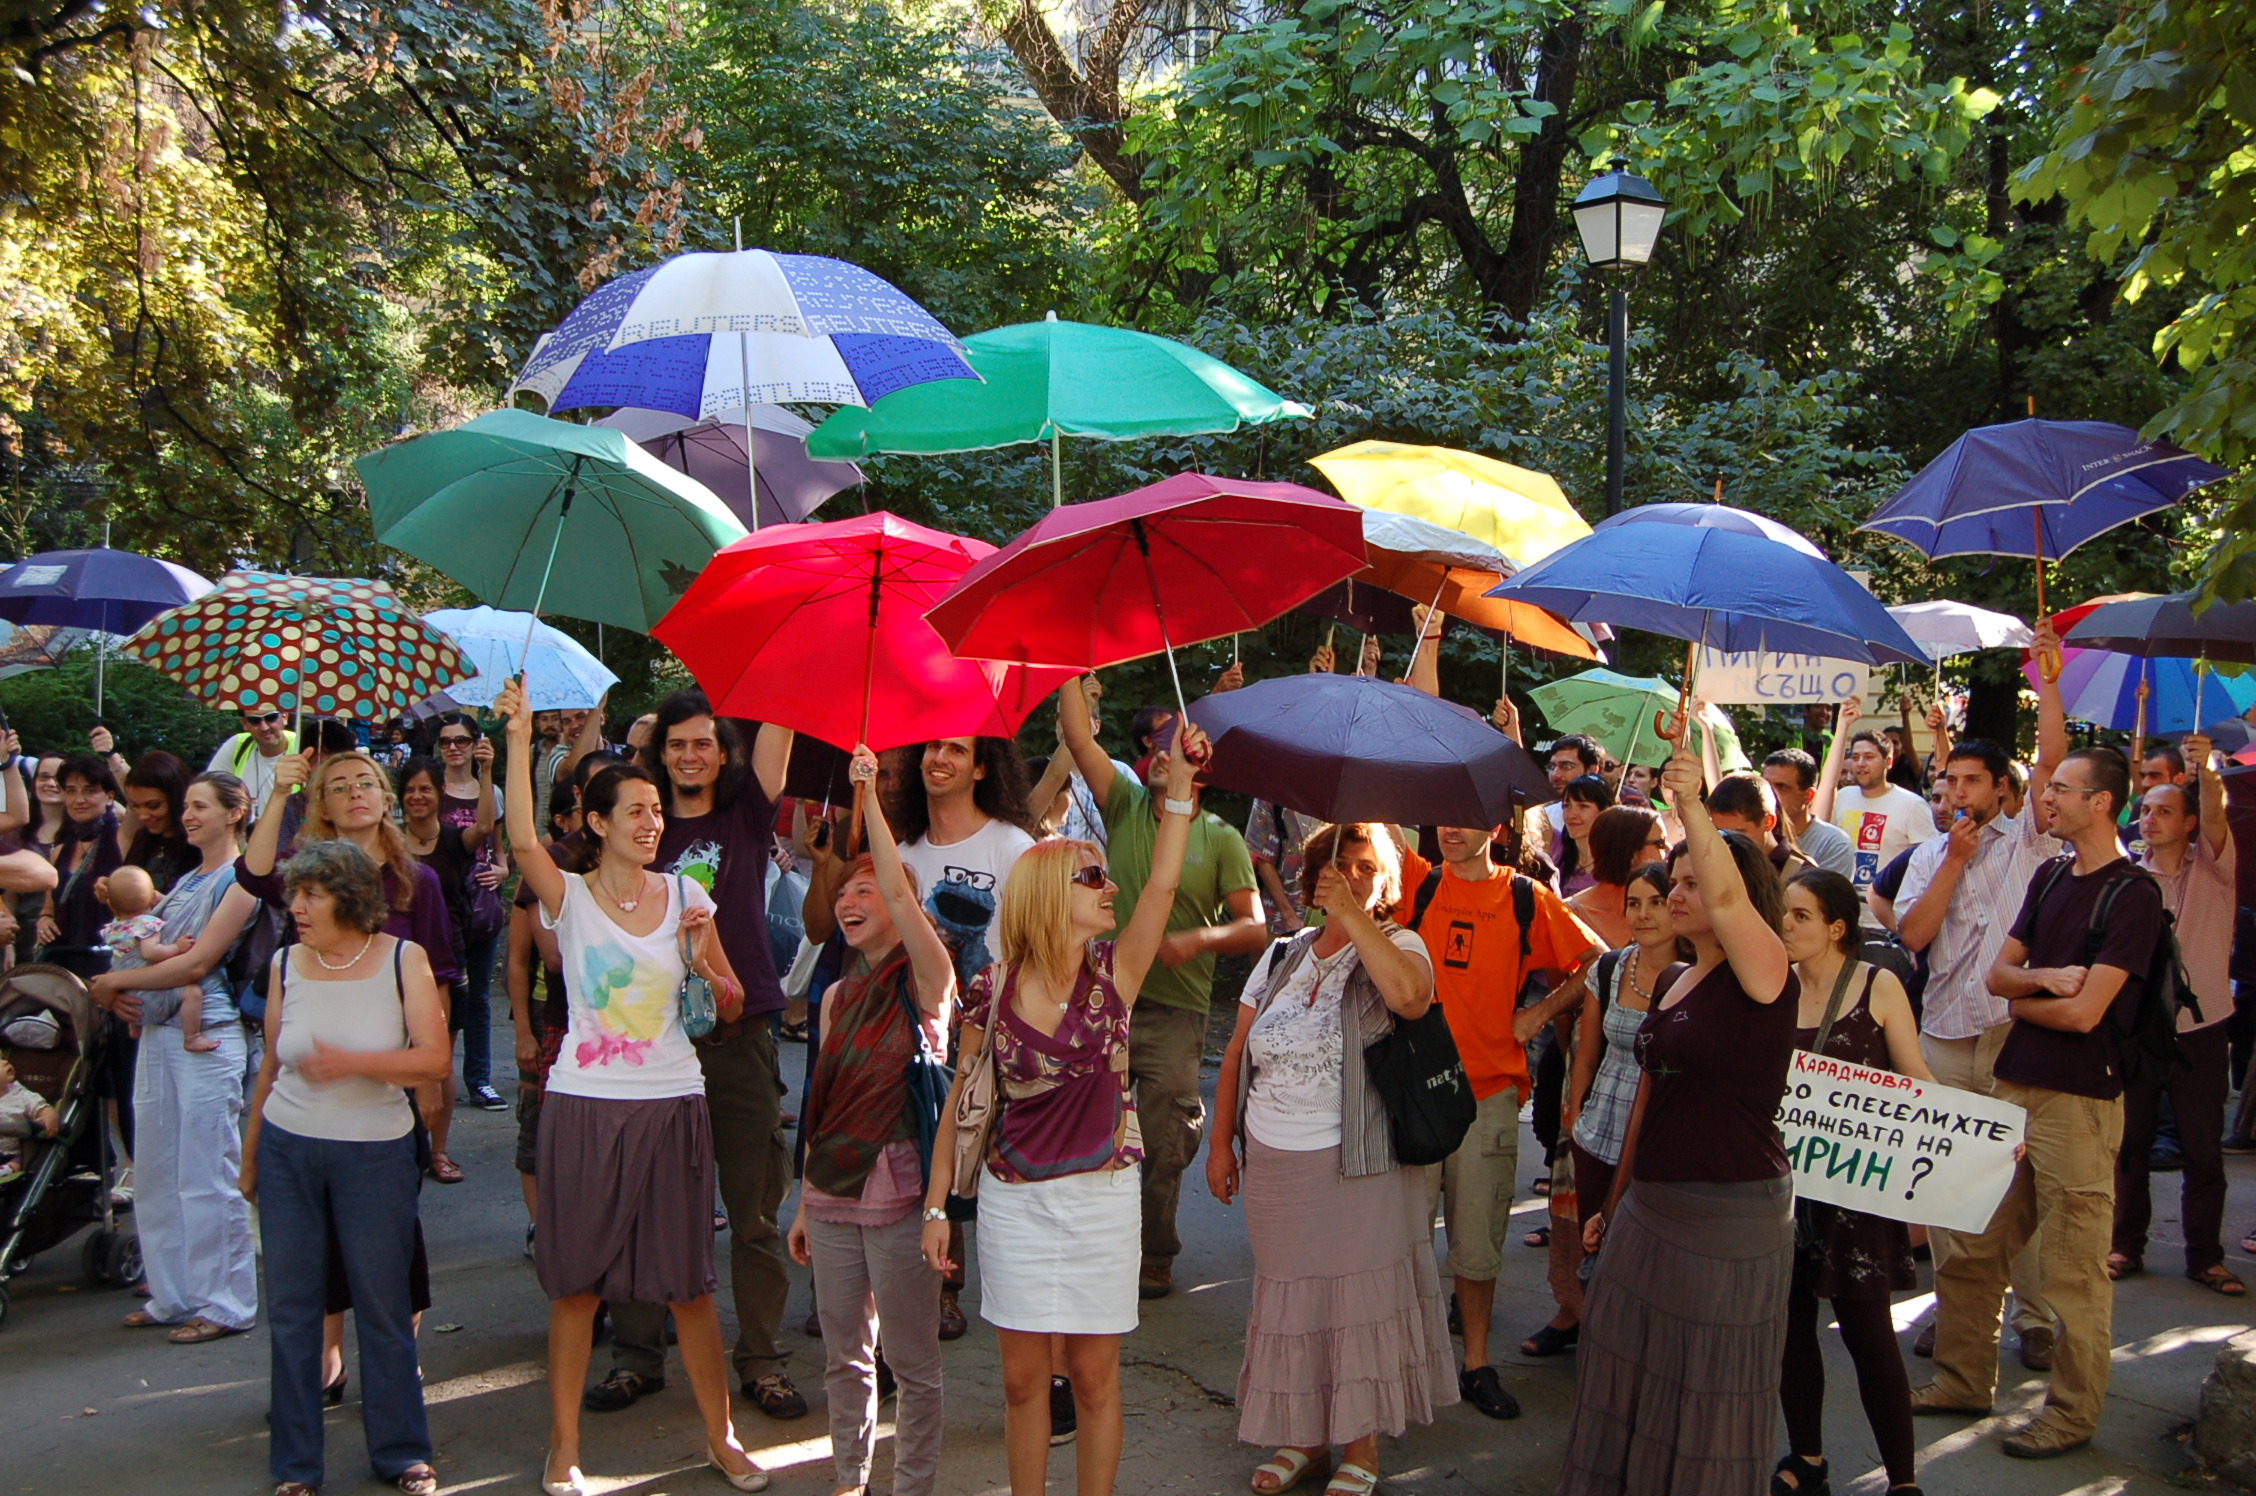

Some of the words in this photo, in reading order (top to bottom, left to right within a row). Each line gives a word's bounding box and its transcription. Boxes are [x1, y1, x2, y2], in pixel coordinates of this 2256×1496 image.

[621, 314, 800, 344] REUTERS
[807, 314, 956, 345] REUTERS
[2081, 458, 2110, 472] INTER
[1756, 672, 1855, 704] СЪЩО
[766, 911, 806, 930] mo
[1476, 909, 1497, 921] Apps
[1917, 1134, 1953, 1157] НА
